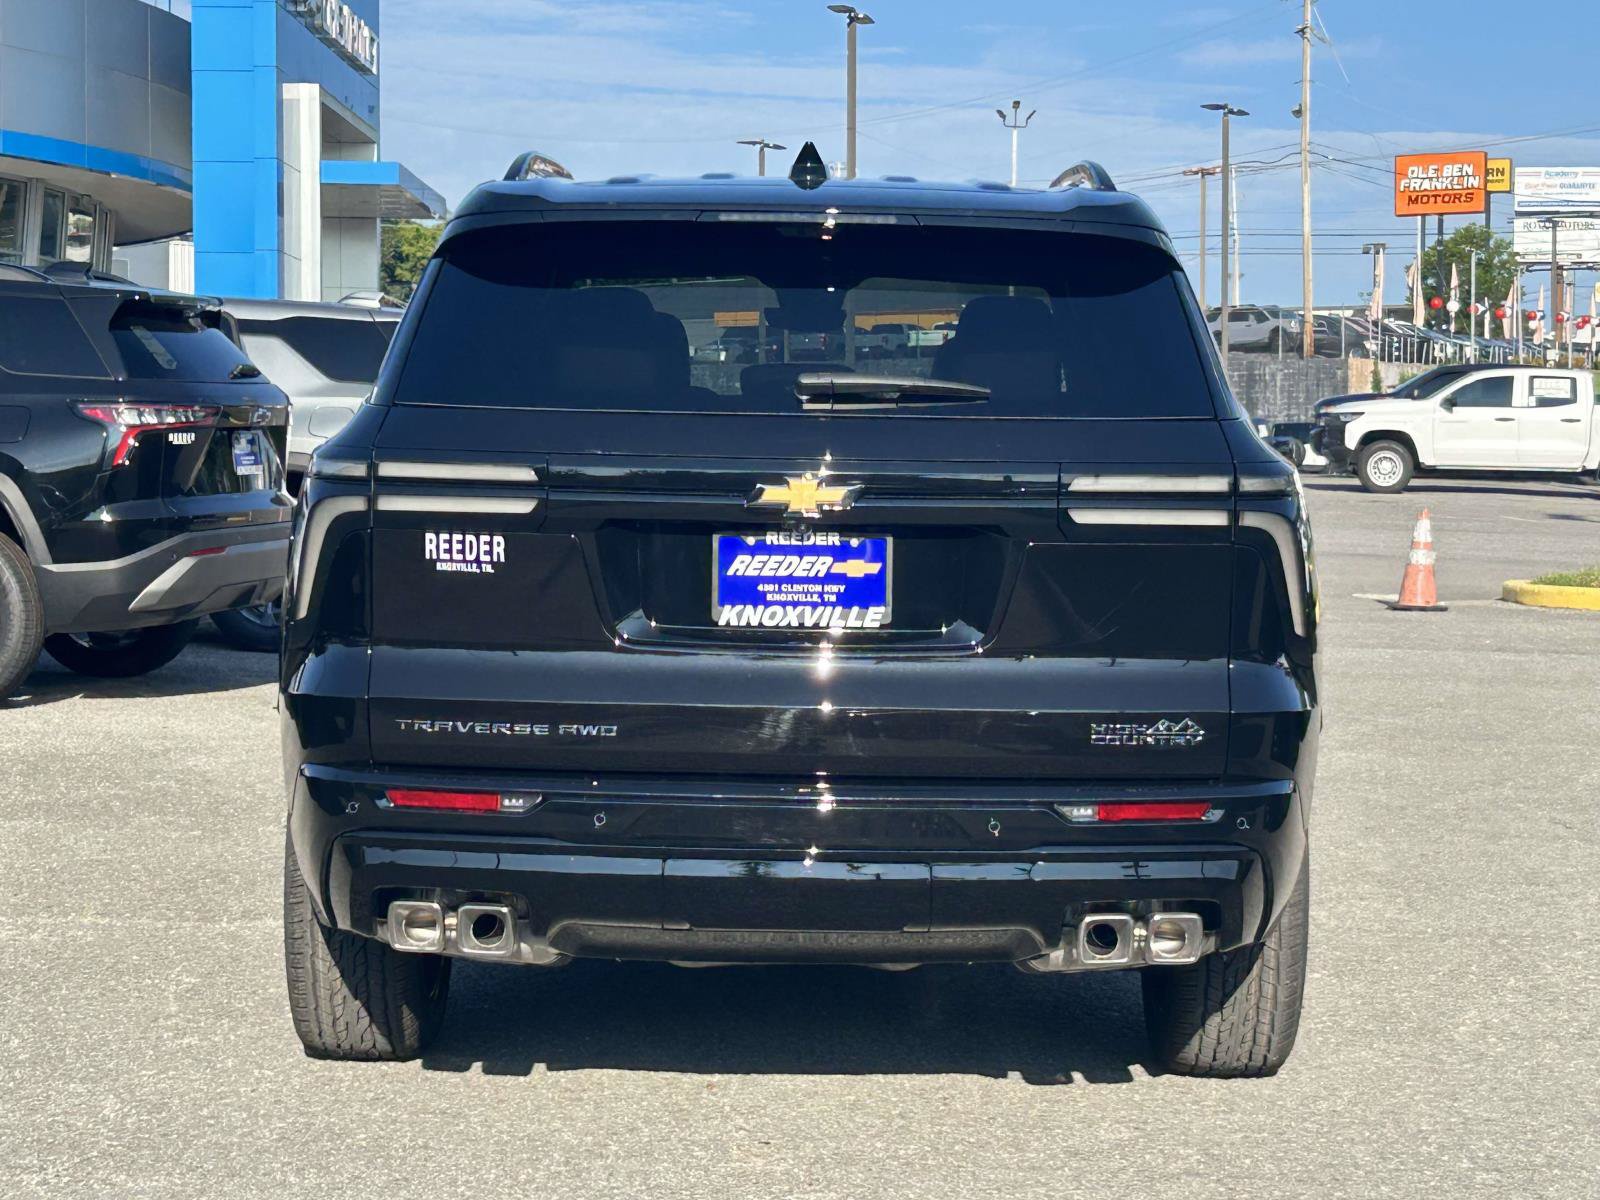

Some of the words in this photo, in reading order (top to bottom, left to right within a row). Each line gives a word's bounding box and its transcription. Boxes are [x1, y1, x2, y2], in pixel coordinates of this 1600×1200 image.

[1407, 165, 1438, 178] OLE
[1442, 163, 1474, 177] BEN
[1399, 175, 1480, 192] FRANKLIN
[1407, 191, 1475, 206] MOTORS
[765, 531, 841, 546] REEDER
[425, 532, 505, 562] REEDER
[727, 555, 833, 577] REEDER
[781, 584, 822, 592] CLINTON
[823, 594, 837, 602] TN
[718, 605, 886, 628] KNOXVILLE
[395, 718, 550, 735] TRAVERSE
[558, 724, 618, 736] AWD
